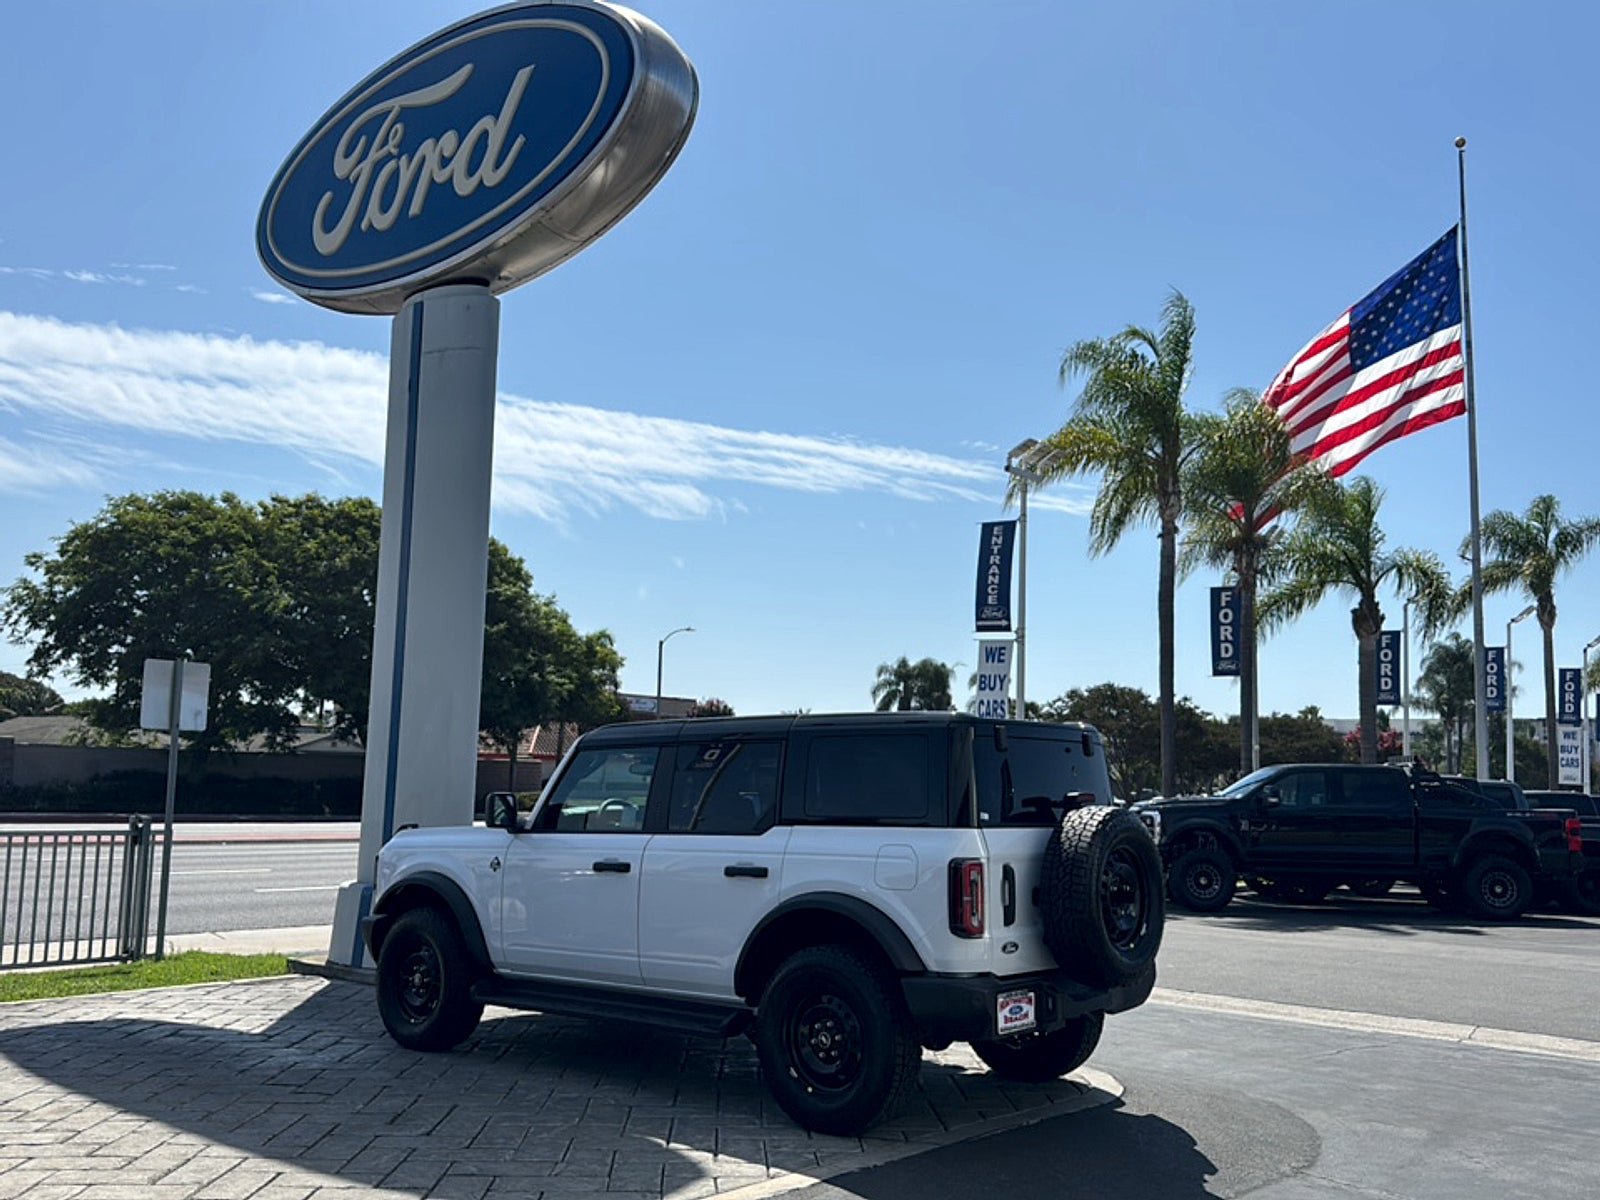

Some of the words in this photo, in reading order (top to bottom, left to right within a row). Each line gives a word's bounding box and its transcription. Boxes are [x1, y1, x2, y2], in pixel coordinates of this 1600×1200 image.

[312, 62, 536, 257] Ford
[987, 526, 1004, 605] ENTRANCE
[1219, 591, 1233, 658] FORD
[985, 646, 1006, 664] WE
[1379, 634, 1393, 690] FORD
[979, 673, 1007, 691] BUY
[1486, 650, 1498, 698] FORD
[1564, 671, 1575, 713] FORD
[978, 700, 1006, 718] CARS
[1560, 745, 1579, 754] BUY
[1563, 731, 1577, 740] WE
[1560, 757, 1579, 768] CARS
